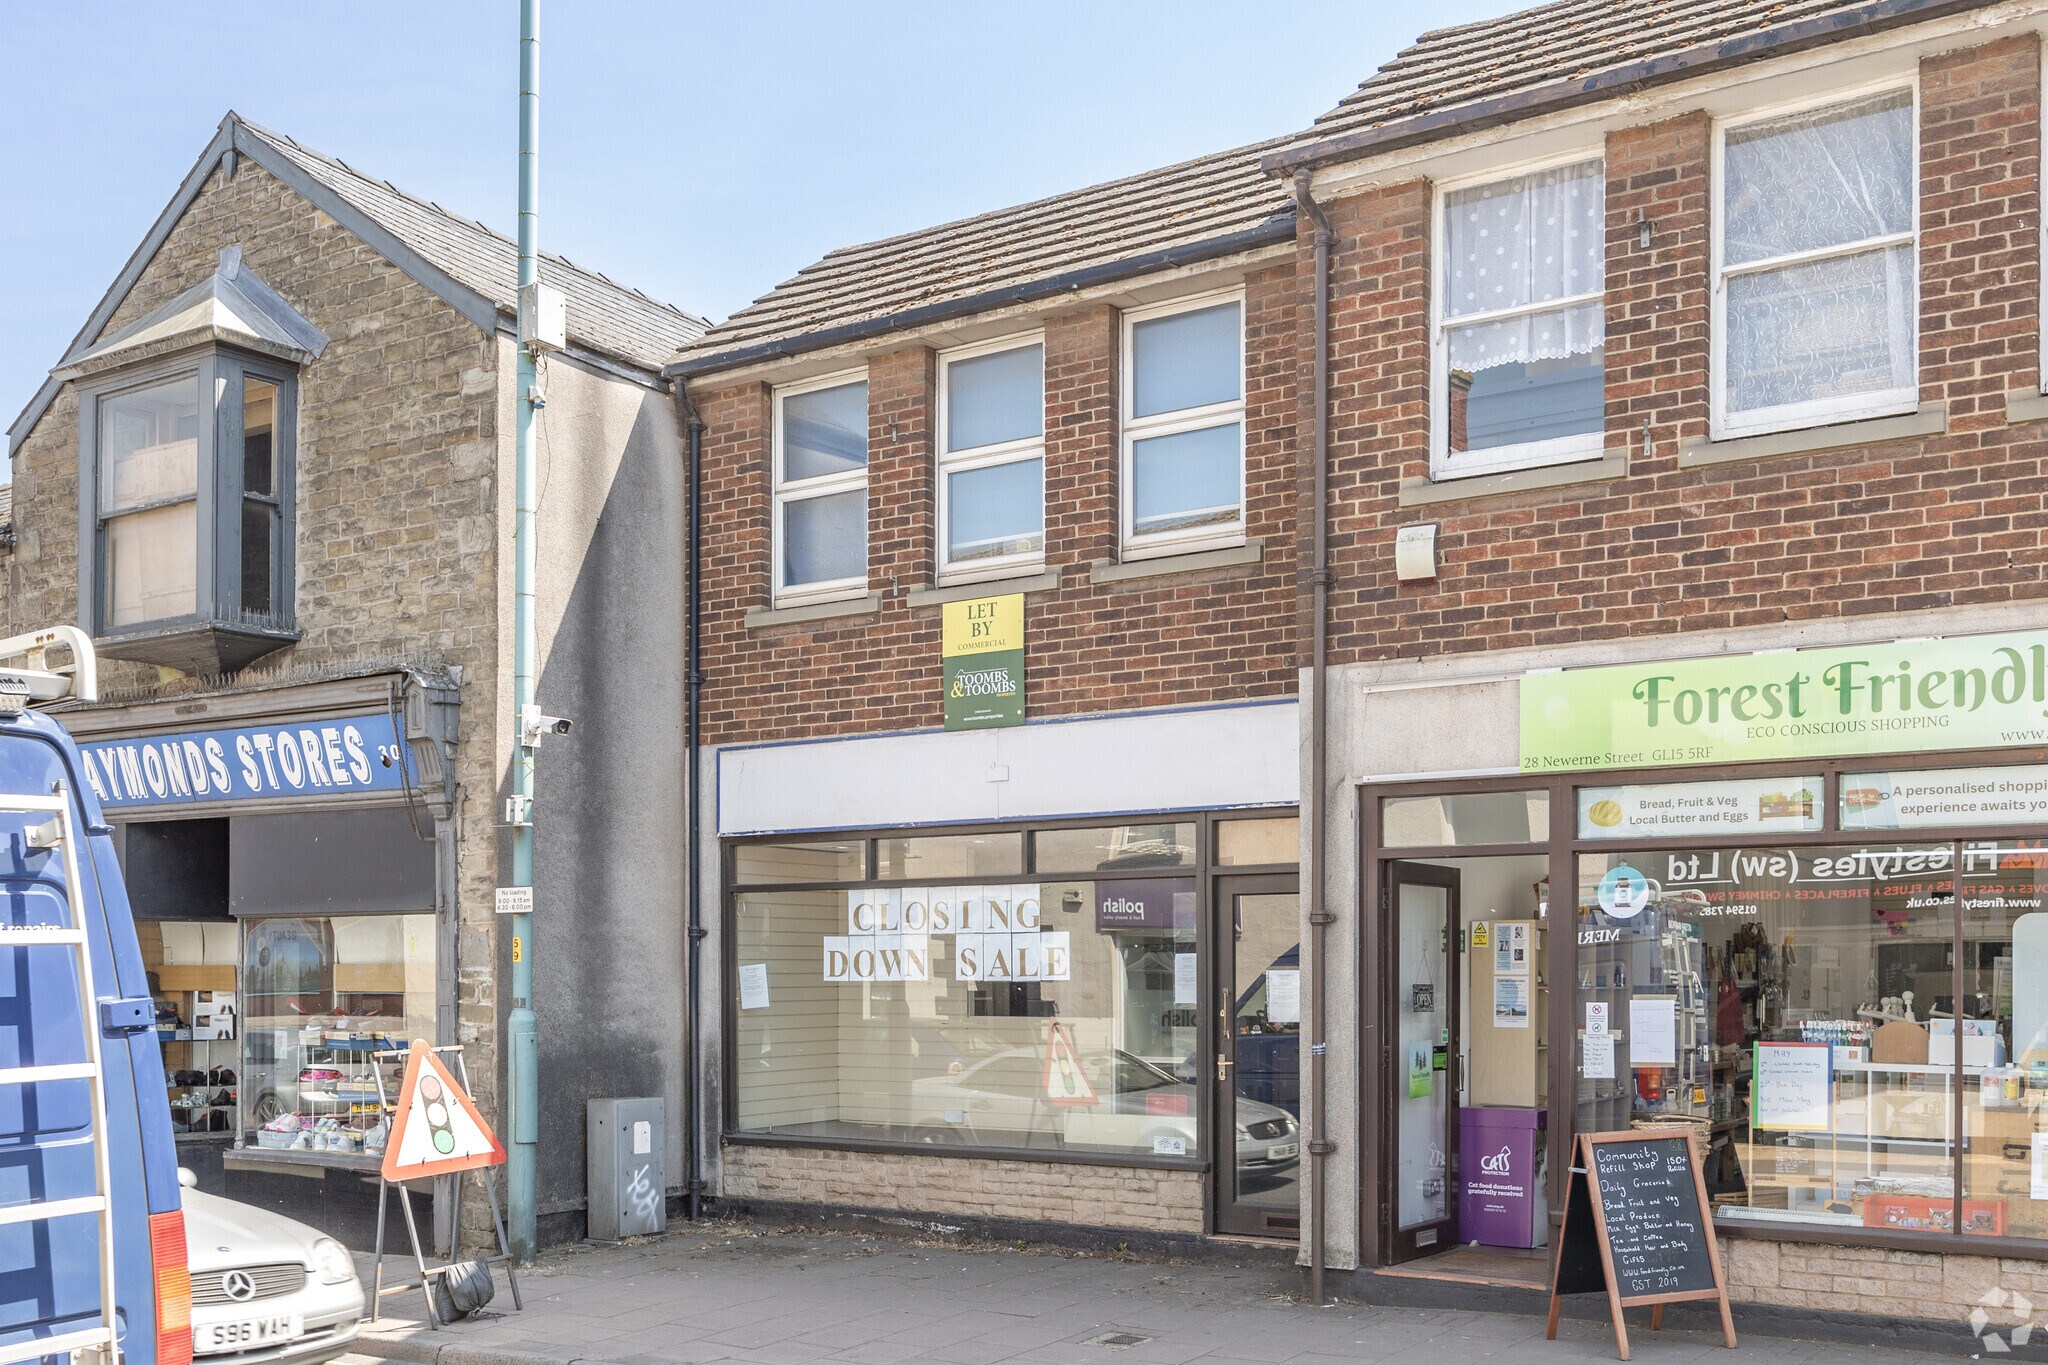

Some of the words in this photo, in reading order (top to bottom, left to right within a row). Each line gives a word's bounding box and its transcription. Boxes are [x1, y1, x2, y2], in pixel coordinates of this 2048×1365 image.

[967, 602, 998, 620] LET
[971, 621, 994, 637] BY
[957, 638, 1007, 651] COMMERCIAL
[957, 669, 1009, 687] TOOMBS
[1632, 672, 1810, 727] Forest
[1822, 644, 2048, 717] Friendl
[950, 680, 965, 698] &
[964, 680, 1016, 697] TOOMBS
[1746, 726, 1776, 738] ECO
[1780, 720, 1866, 737] CONSCIOUS
[1870, 715, 1950, 731] SHOPPING
[236, 725, 373, 792] STORES
[1523, 757, 1539, 769] 28
[1542, 753, 1601, 768] Newerne
[1604, 751, 1644, 764] Street
[1652, 749, 1684, 761] GL15
[1688, 746, 1714, 759] 5RF
[1893, 786, 1902, 796] A
[1906, 781, 1995, 798] personalised
[1999, 779, 2048, 794] shoppi
[1639, 799, 1676, 810] Bread,
[1677, 797, 1704, 808] Fruit
[1706, 797, 1715, 806] &
[1716, 796, 1738, 807] Veg
[1900, 801, 1977, 816] experience
[1980, 799, 2026, 811] awaits
[2029, 800, 2048, 813] yo
[1629, 813, 1659, 826] Local
[1661, 813, 1696, 824] Butter
[1699, 812, 1720, 822] and
[1723, 811, 1749, 823] Eggs
[852, 898, 1041, 932] CLOSING
[827, 949, 927, 978] DOWN
[960, 946, 1068, 978] SALE
[1416, 993, 1432, 1006] OPEN
[1773, 1050, 1791, 1058] MAY
[1791, 1081, 1803, 1091] Day
[1480, 1145, 1512, 1172] CATS
[1596, 1146, 1659, 1163] Community
[1666, 1156, 1687, 1165] 150+
[1600, 1163, 1626, 1174] Refill
[1632, 1161, 1656, 1171] Shop
[1467, 1188, 1498, 1197] gratefully
[1497, 1190, 1524, 1198] received
[1492, 1183, 1524, 1191] donations
[1600, 1179, 1627, 1198] Daily
[1633, 1177, 1671, 1188] Groceries
[1603, 1199, 1626, 1211] Bread
[1628, 1198, 1645, 1207] Fruit
[1605, 1213, 1626, 1223] Local
[1629, 1211, 1661, 1221] Produce
[1643, 1221, 1663, 1230] Butter
[1675, 1219, 1695, 1233] Honey
[1610, 1235, 1624, 1244] Tea
[1670, 1240, 1688, 1252] Body
[1622, 1254, 1646, 1265] Gifts
[1631, 1278, 1651, 1291] EST
[1658, 1276, 1679, 1288] 2019
[213, 1322, 251, 1345] S96
